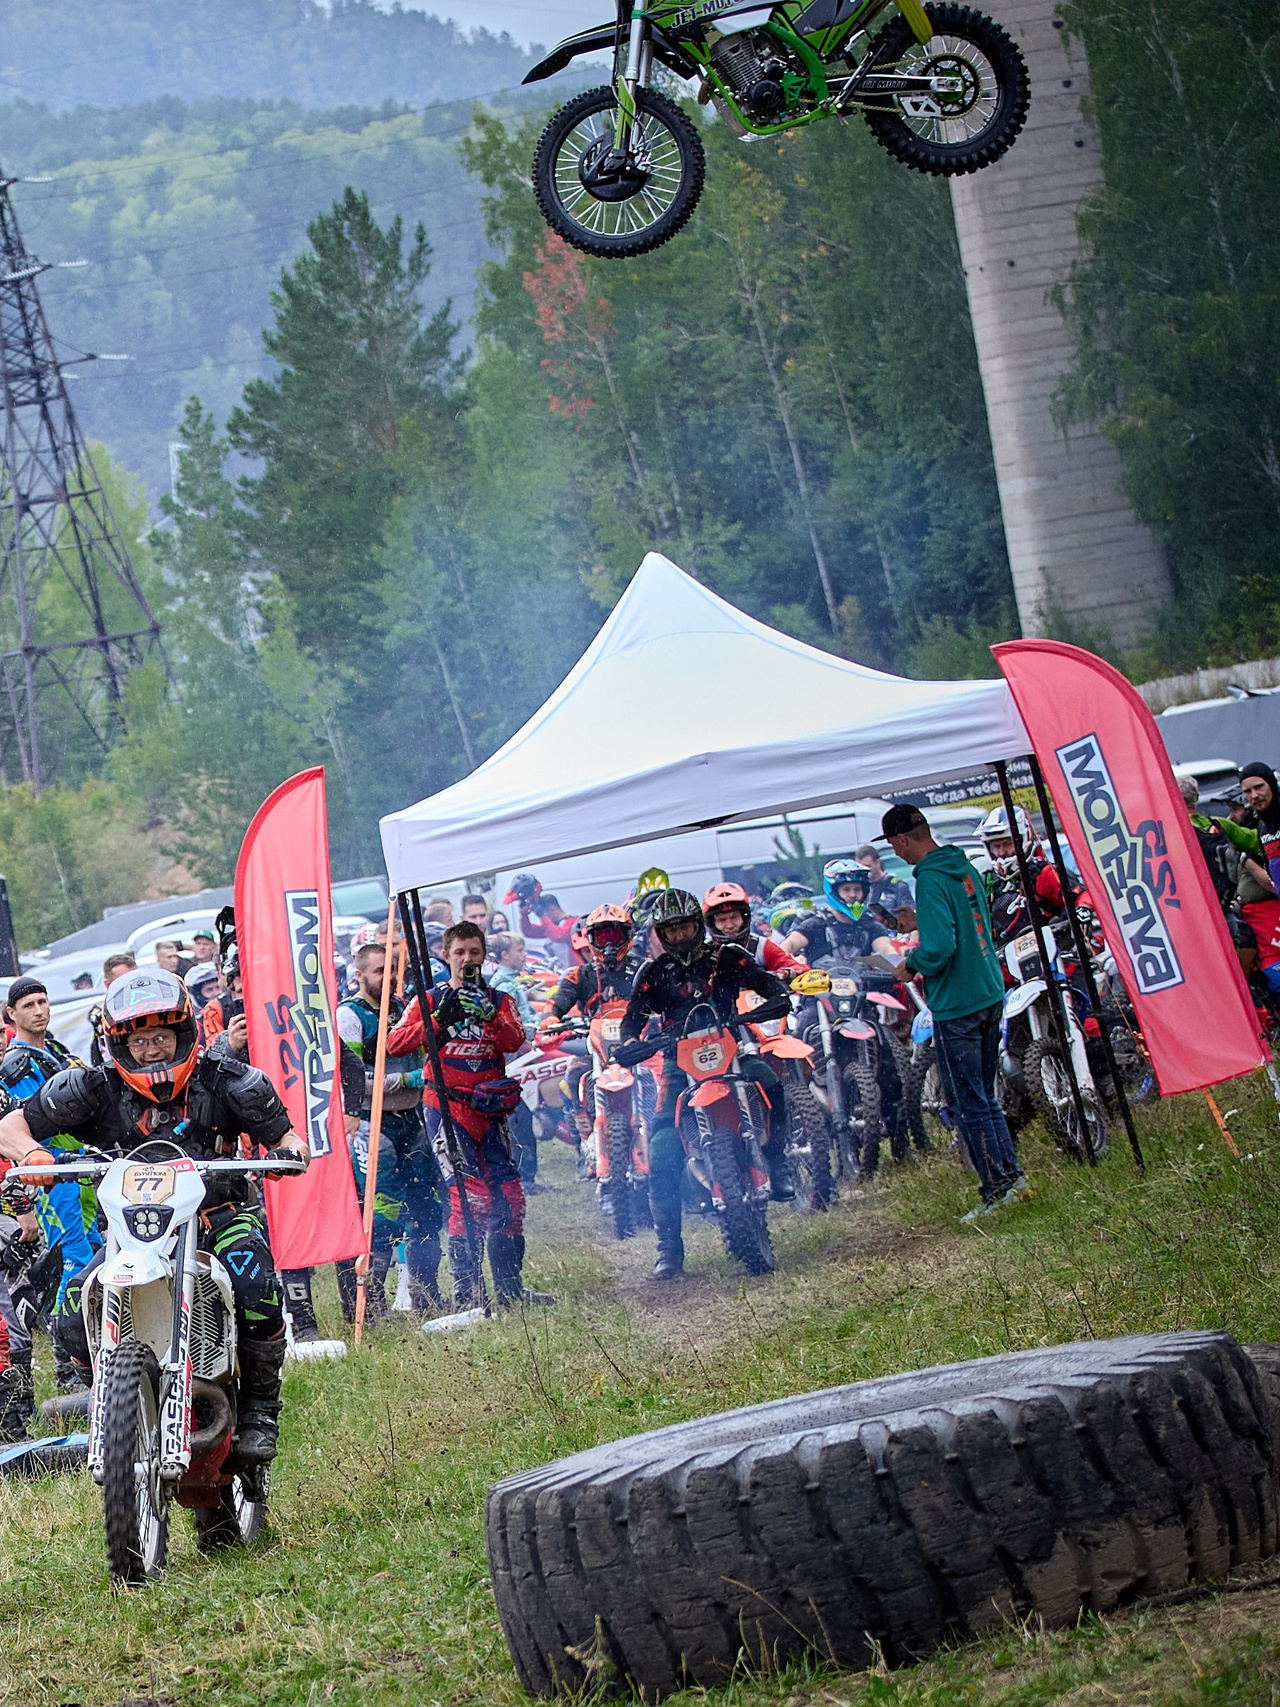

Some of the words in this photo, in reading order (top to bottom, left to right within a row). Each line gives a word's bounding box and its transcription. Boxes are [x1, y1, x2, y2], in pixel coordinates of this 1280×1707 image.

[925, 788, 967, 805] Тогда
[969, 780, 1000, 798] тебе
[698, 1052, 718, 1064] 62
[134, 1177, 163, 1191] 77
